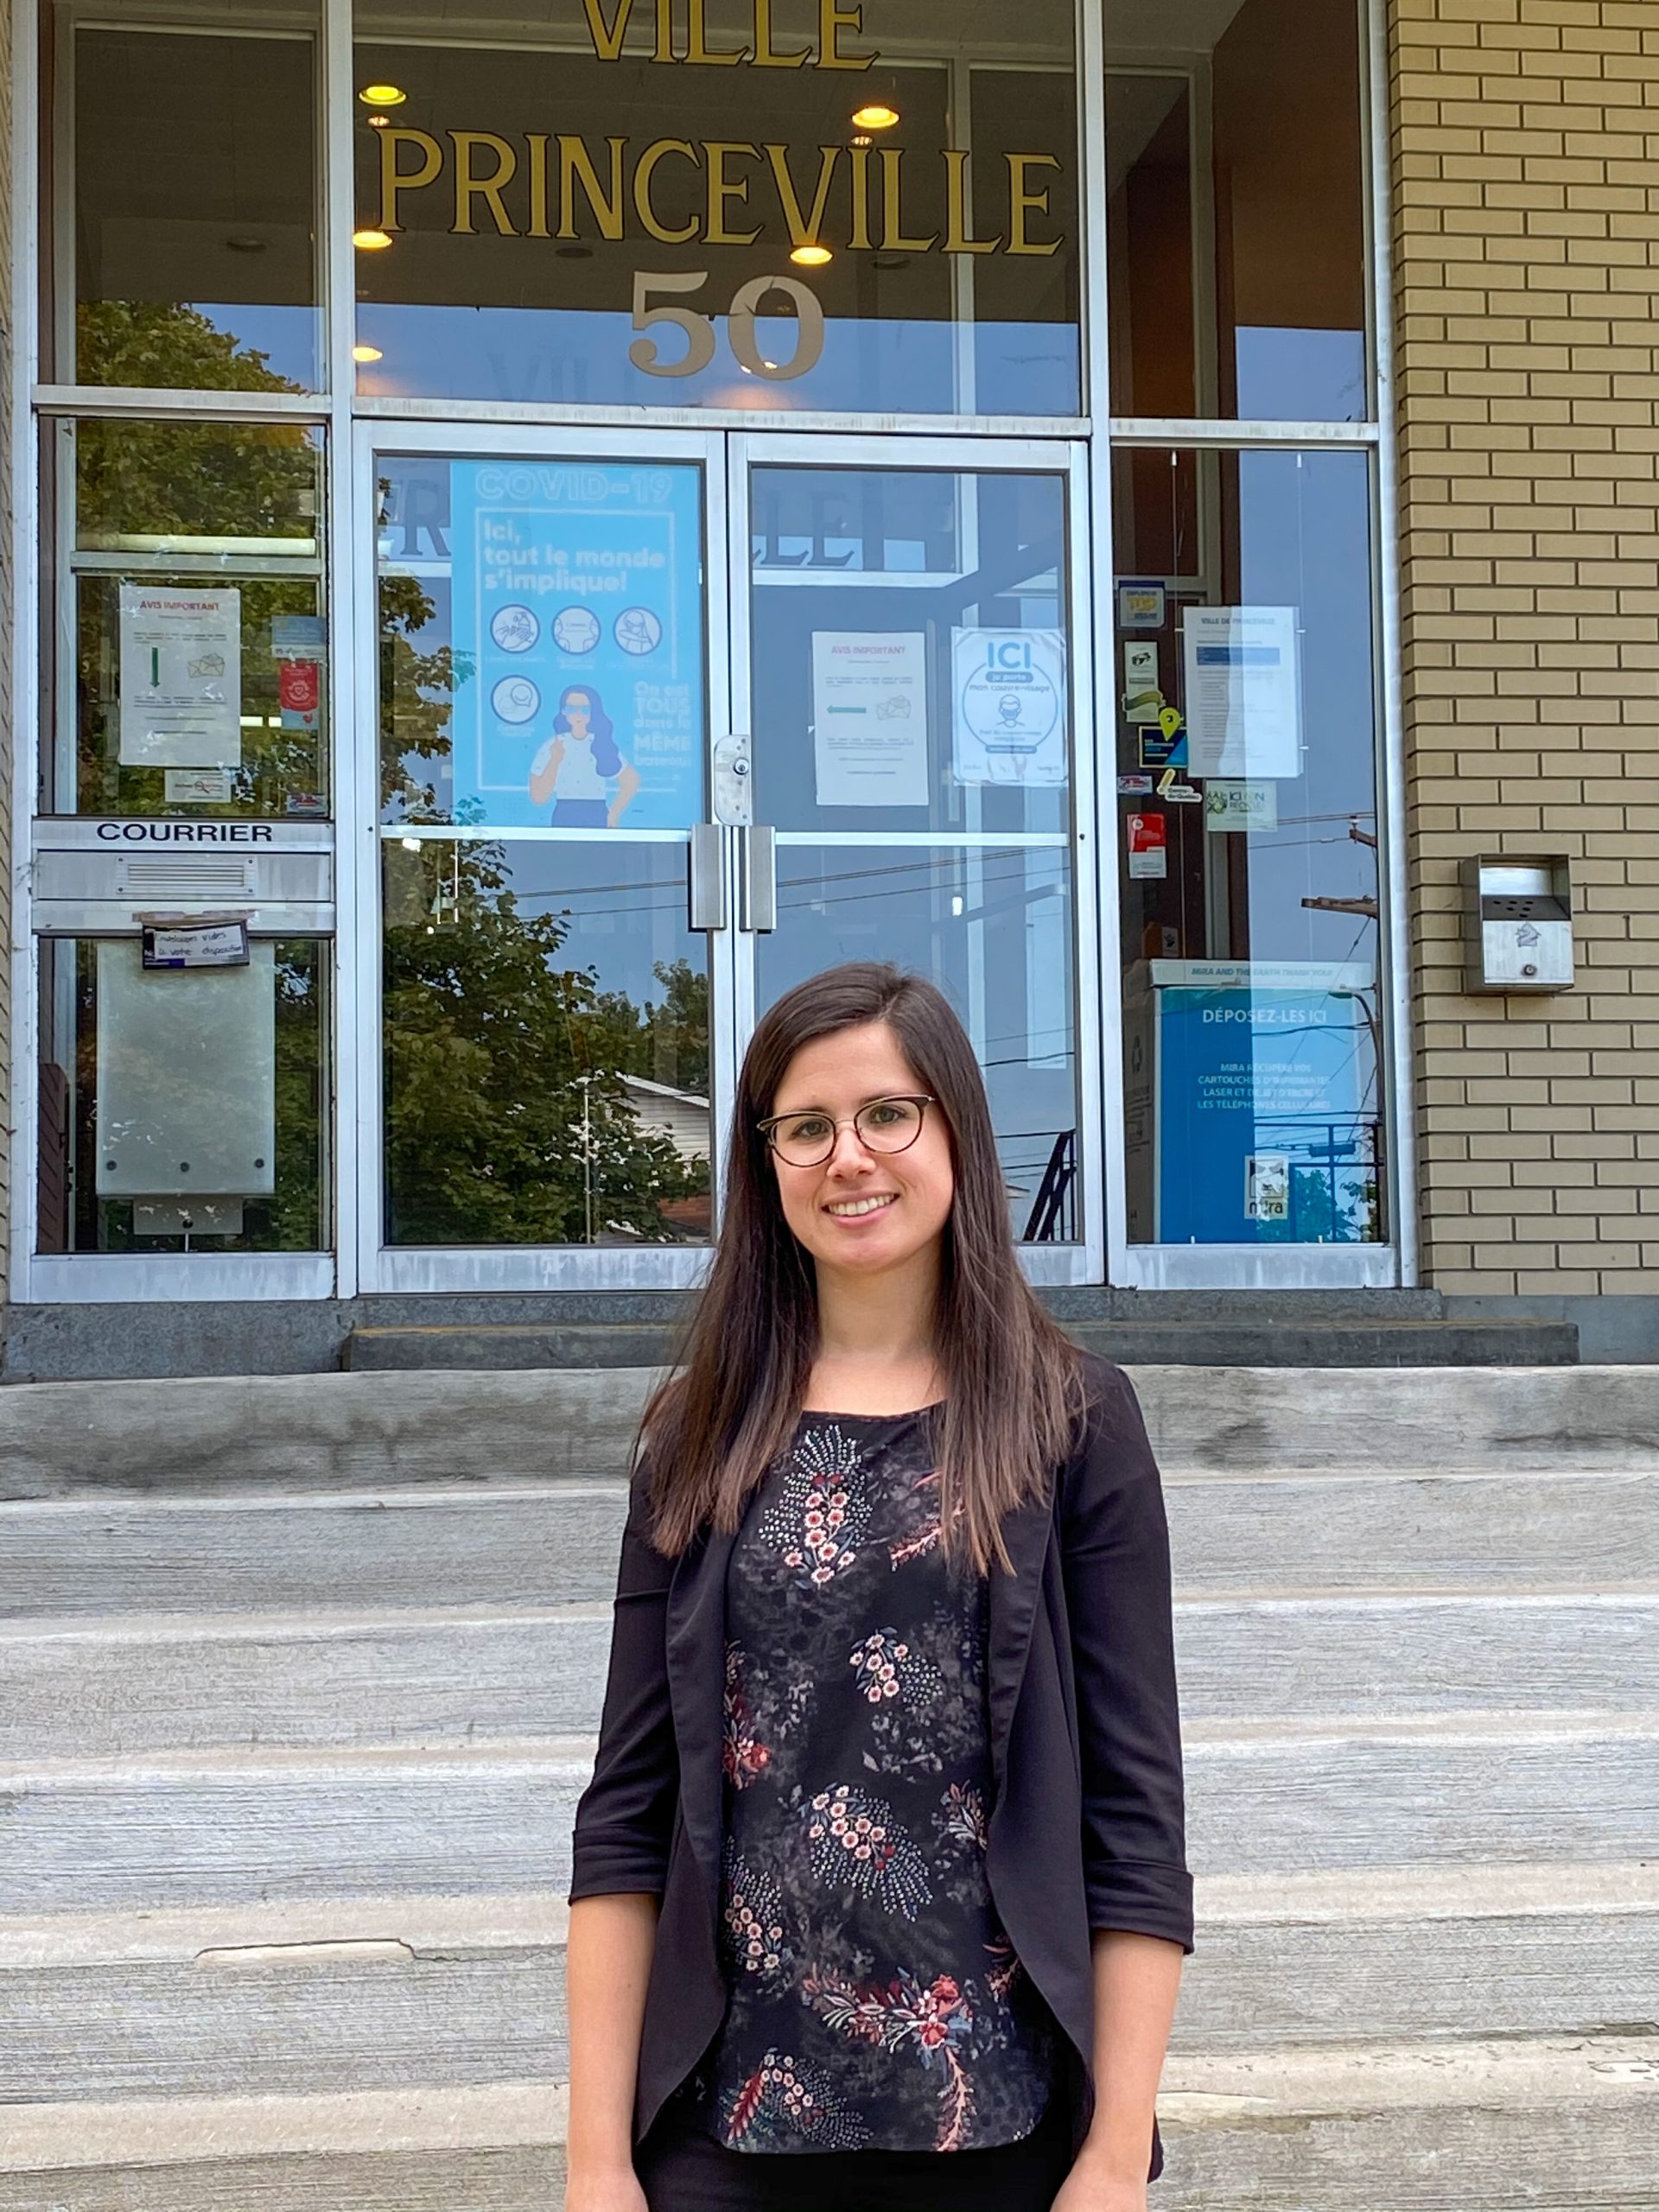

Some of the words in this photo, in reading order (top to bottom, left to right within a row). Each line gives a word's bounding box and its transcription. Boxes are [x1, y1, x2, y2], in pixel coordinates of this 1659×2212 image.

[587, 0, 880, 71] VILLE
[373, 126, 1065, 256] PRINCEVILLE
[628, 270, 825, 382] 50
[475, 468, 673, 504] COVID-19
[484, 518, 521, 546] Ici,
[484, 545, 539, 566] tout
[544, 543, 569, 566] le
[575, 547, 665, 569] monde
[484, 568, 626, 595] s'implique!
[139, 601, 162, 610] AVIS
[163, 601, 219, 611] IMPORTANT
[830, 646, 850, 655] AVIS
[853, 646, 906, 655] IMPORTANT
[987, 642, 1032, 669] ICI
[633, 696, 691, 714] TOUS
[96, 823, 273, 842] COURRIER
[1203, 1007, 1306, 1023] DÉPOSEZ-LES
[1309, 1009, 1326, 1023] ICI
[1220, 1064, 1245, 1072] MIRA
[1295, 1064, 1312, 1072] VOS
[1198, 1076, 1261, 1084] CARTOUCHES
[1204, 1088, 1233, 1097] LASER
[1235, 1088, 1245, 1097] ET
